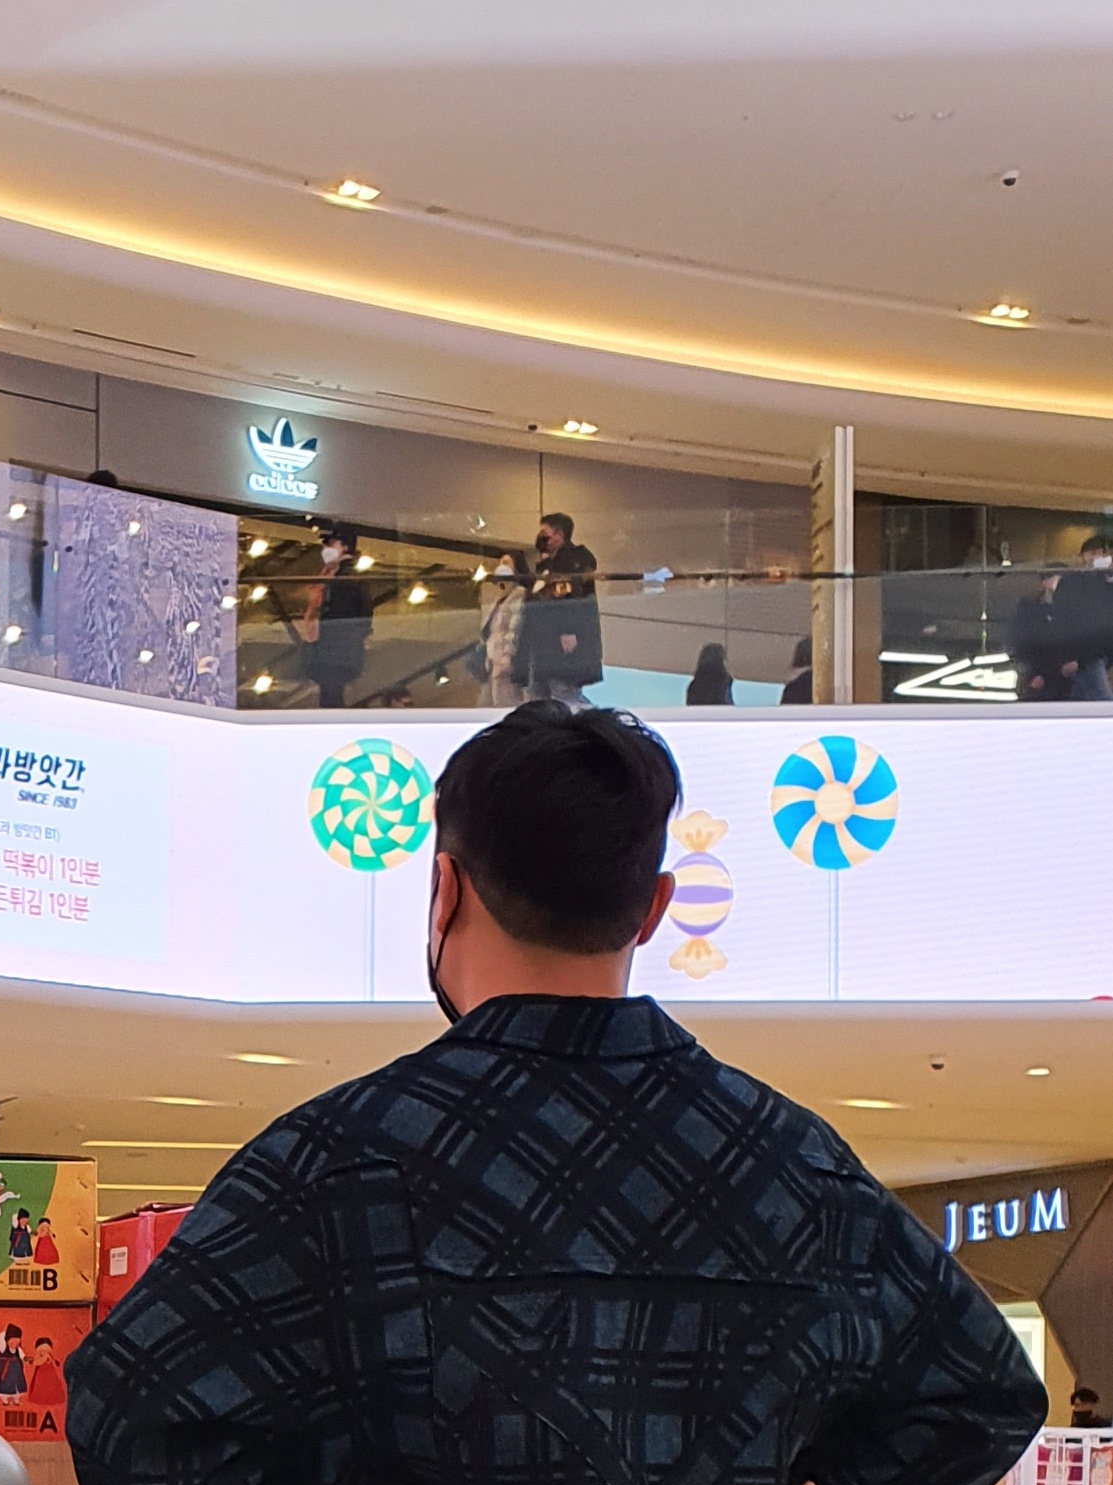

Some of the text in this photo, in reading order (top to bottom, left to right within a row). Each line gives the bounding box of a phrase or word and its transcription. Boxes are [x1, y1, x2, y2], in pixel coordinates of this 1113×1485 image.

[249, 471, 318, 500] adidas
[18, 789, 49, 805] SINCE
[3, 849, 53, 881] 떡볶이
[60, 857, 101, 886] 1인분
[49, 892, 90, 922] 1인분
[944, 1187, 1067, 1254] JEUM
[43, 1268, 58, 1291] B
[39, 1410, 58, 1433] A
